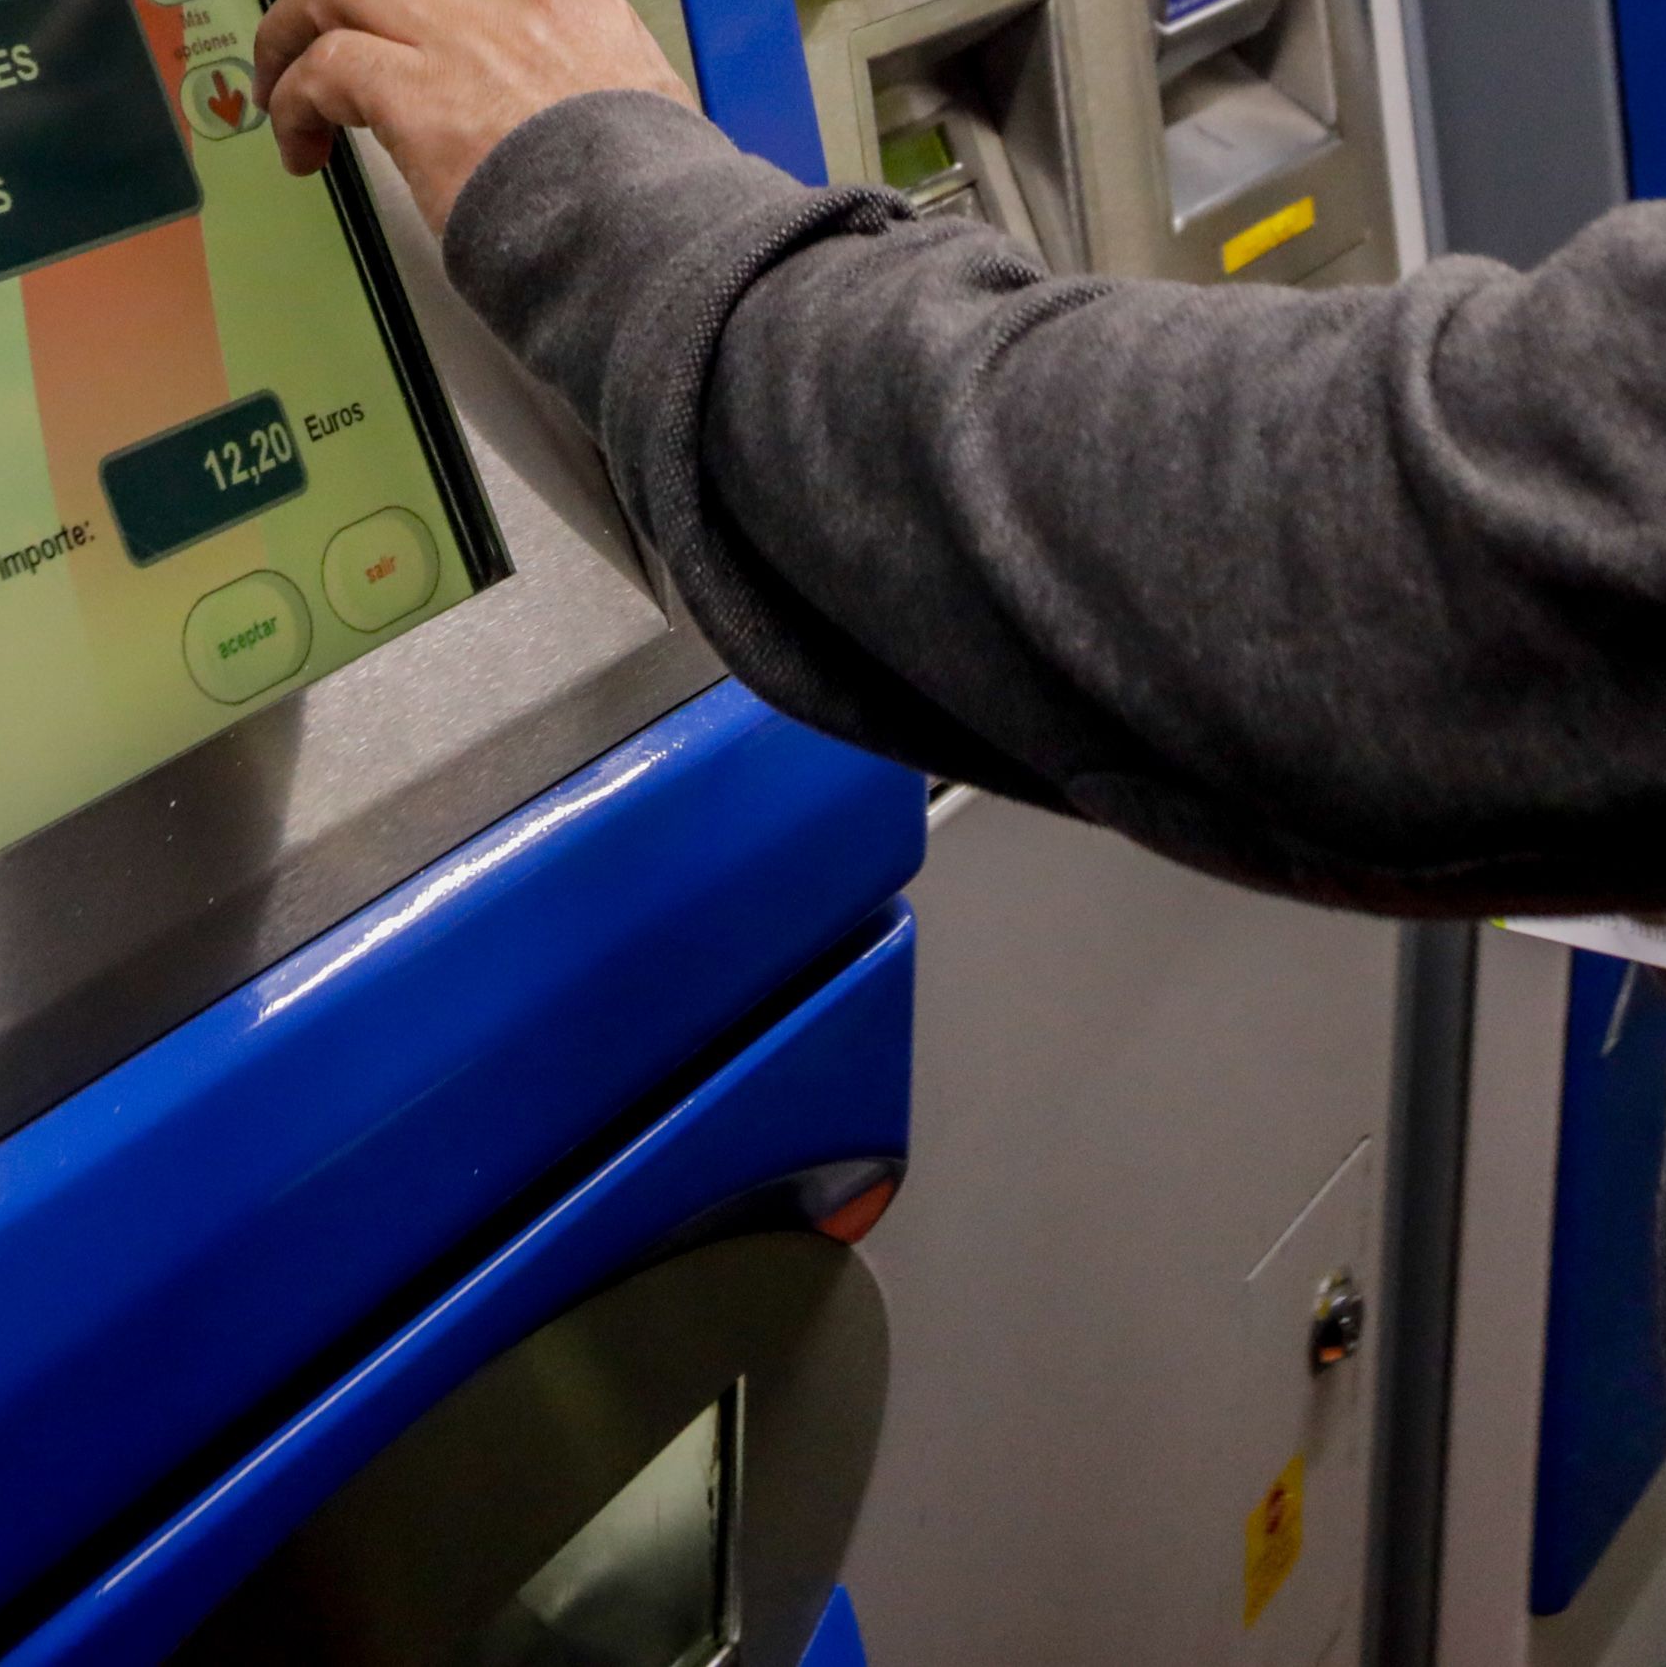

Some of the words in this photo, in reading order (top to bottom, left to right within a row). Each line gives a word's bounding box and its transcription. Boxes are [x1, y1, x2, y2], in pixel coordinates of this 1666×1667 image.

[304, 400, 366, 443] Euros
[203, 421, 294, 493] 12,20
[364, 554, 398, 584] salir
[216, 615, 279, 660] aceptar
